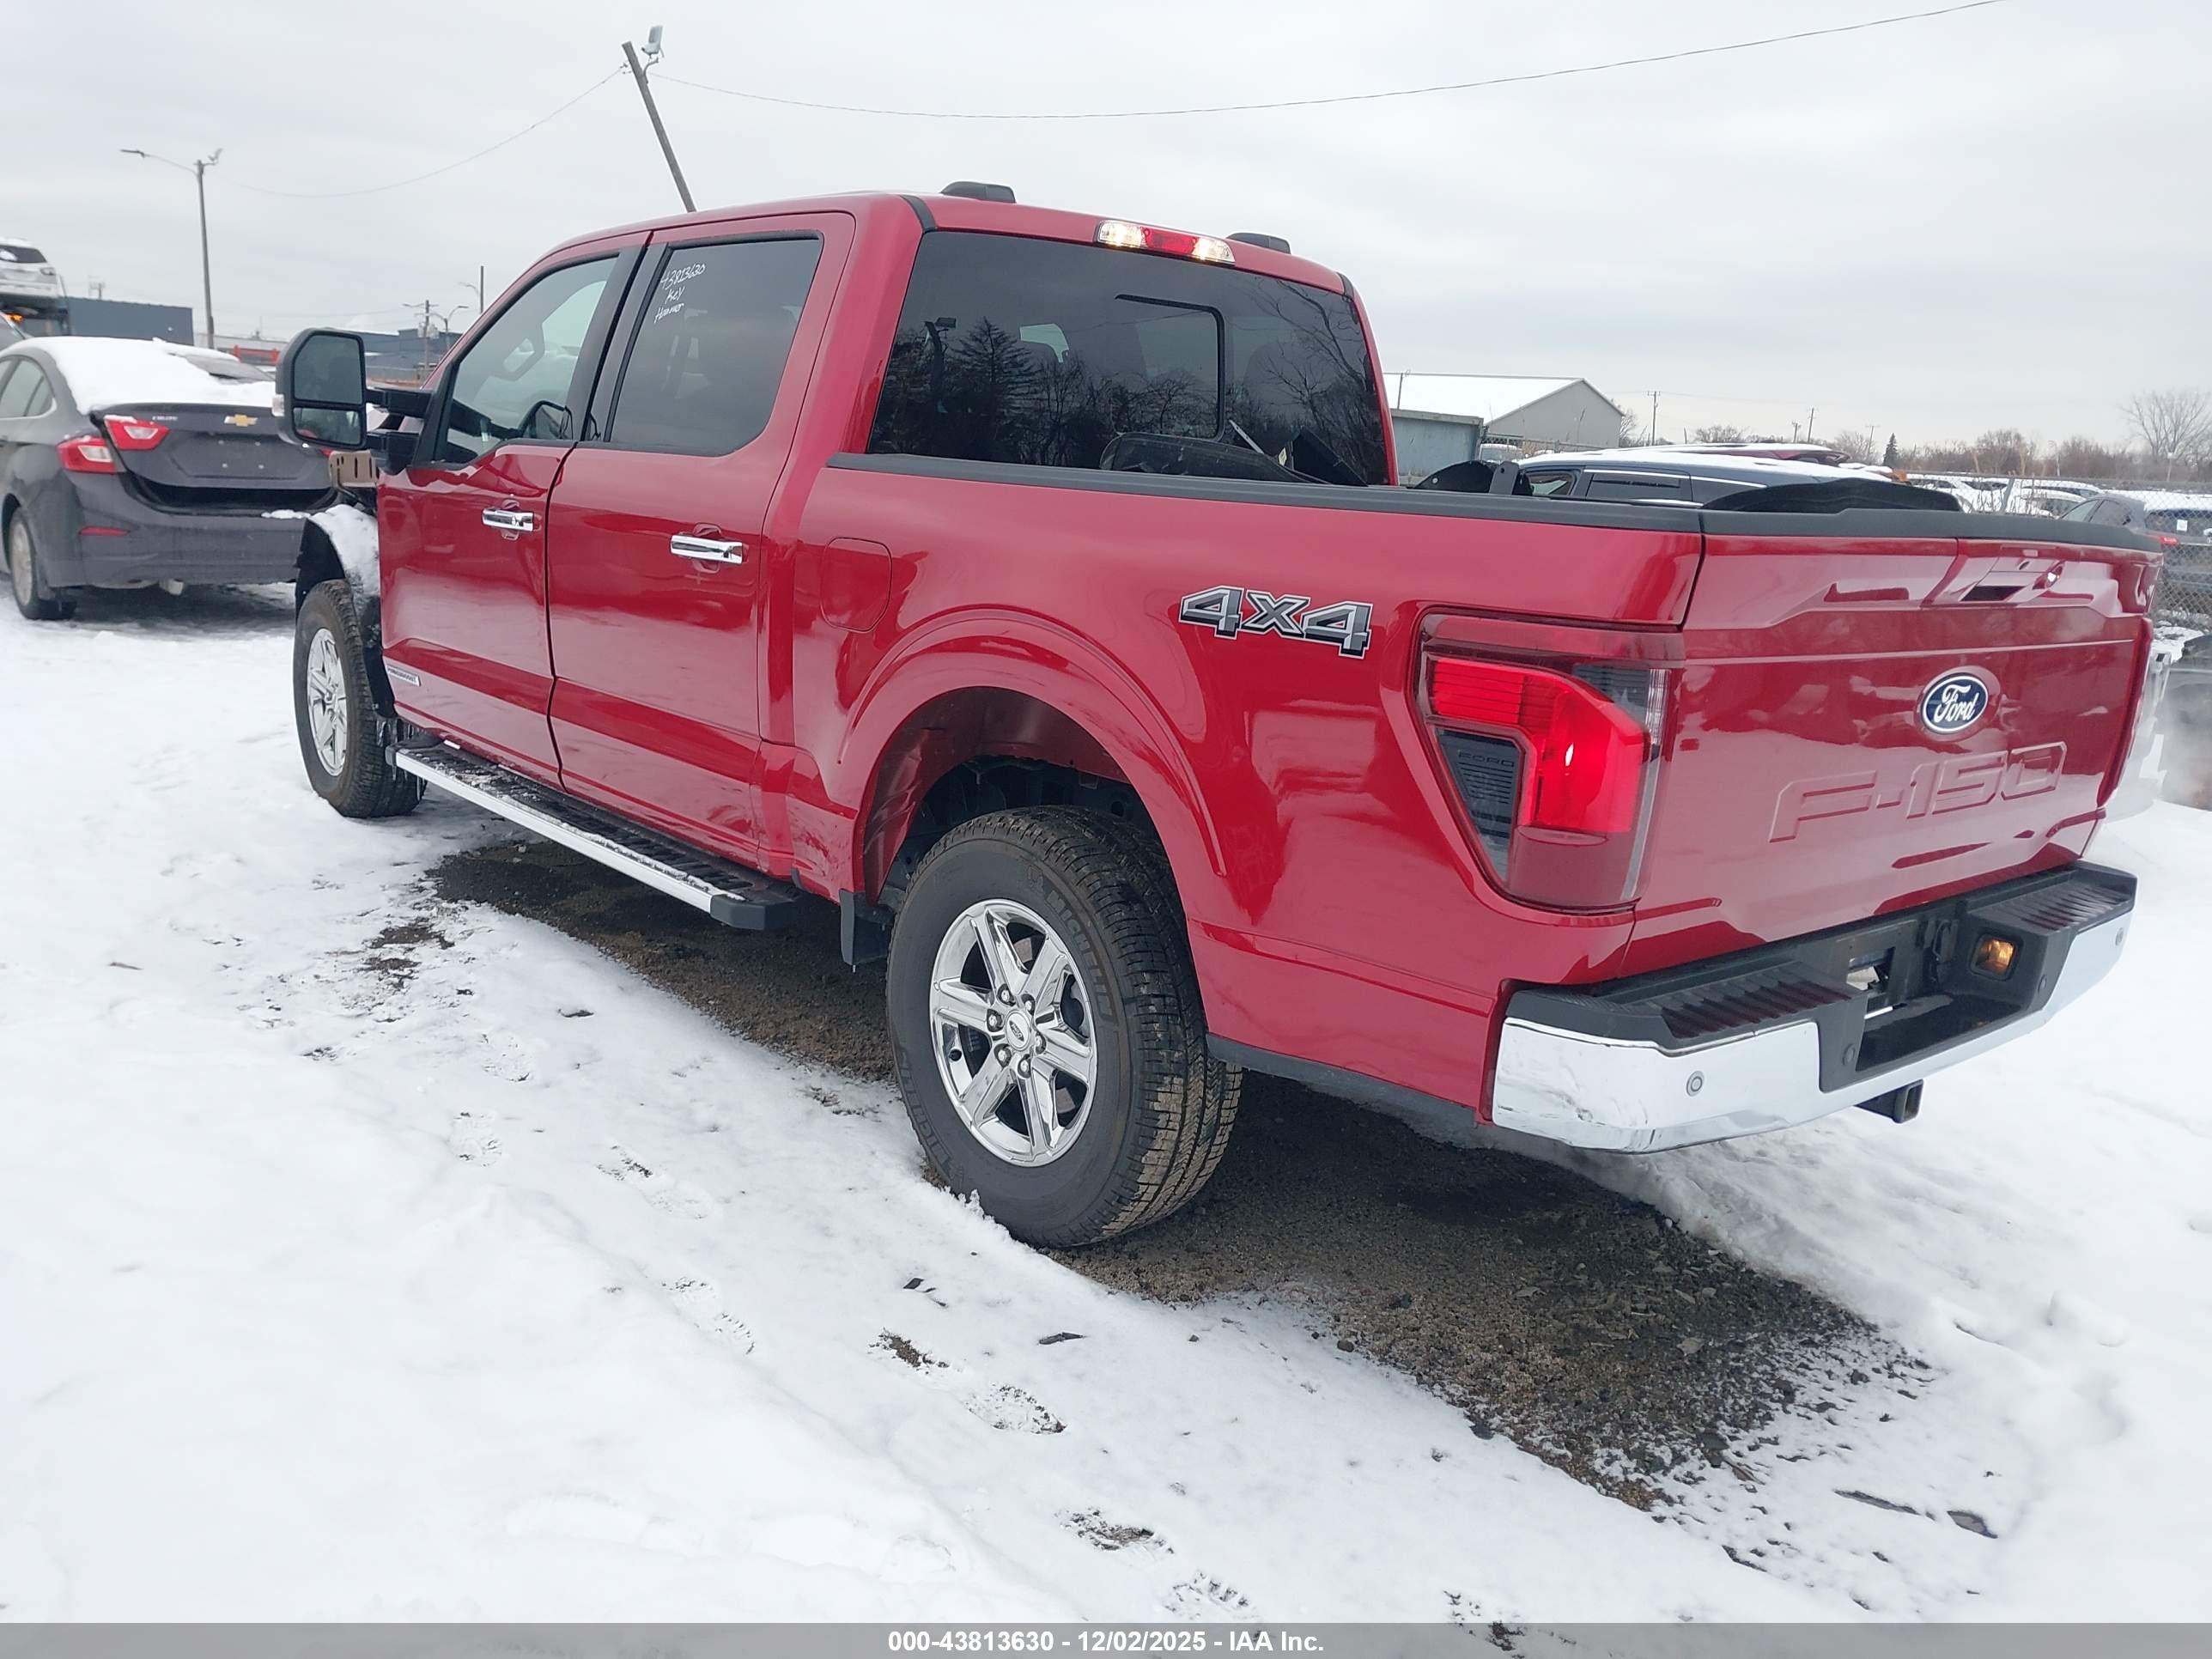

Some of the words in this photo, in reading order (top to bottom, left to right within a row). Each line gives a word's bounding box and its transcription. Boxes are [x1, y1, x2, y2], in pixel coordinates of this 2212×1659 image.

[1933, 684, 1980, 723] Ford
[1458, 751, 1516, 768] FORD
[1769, 741, 2067, 843] F-150
[1045, 890, 1114, 1018] MICHELIN
